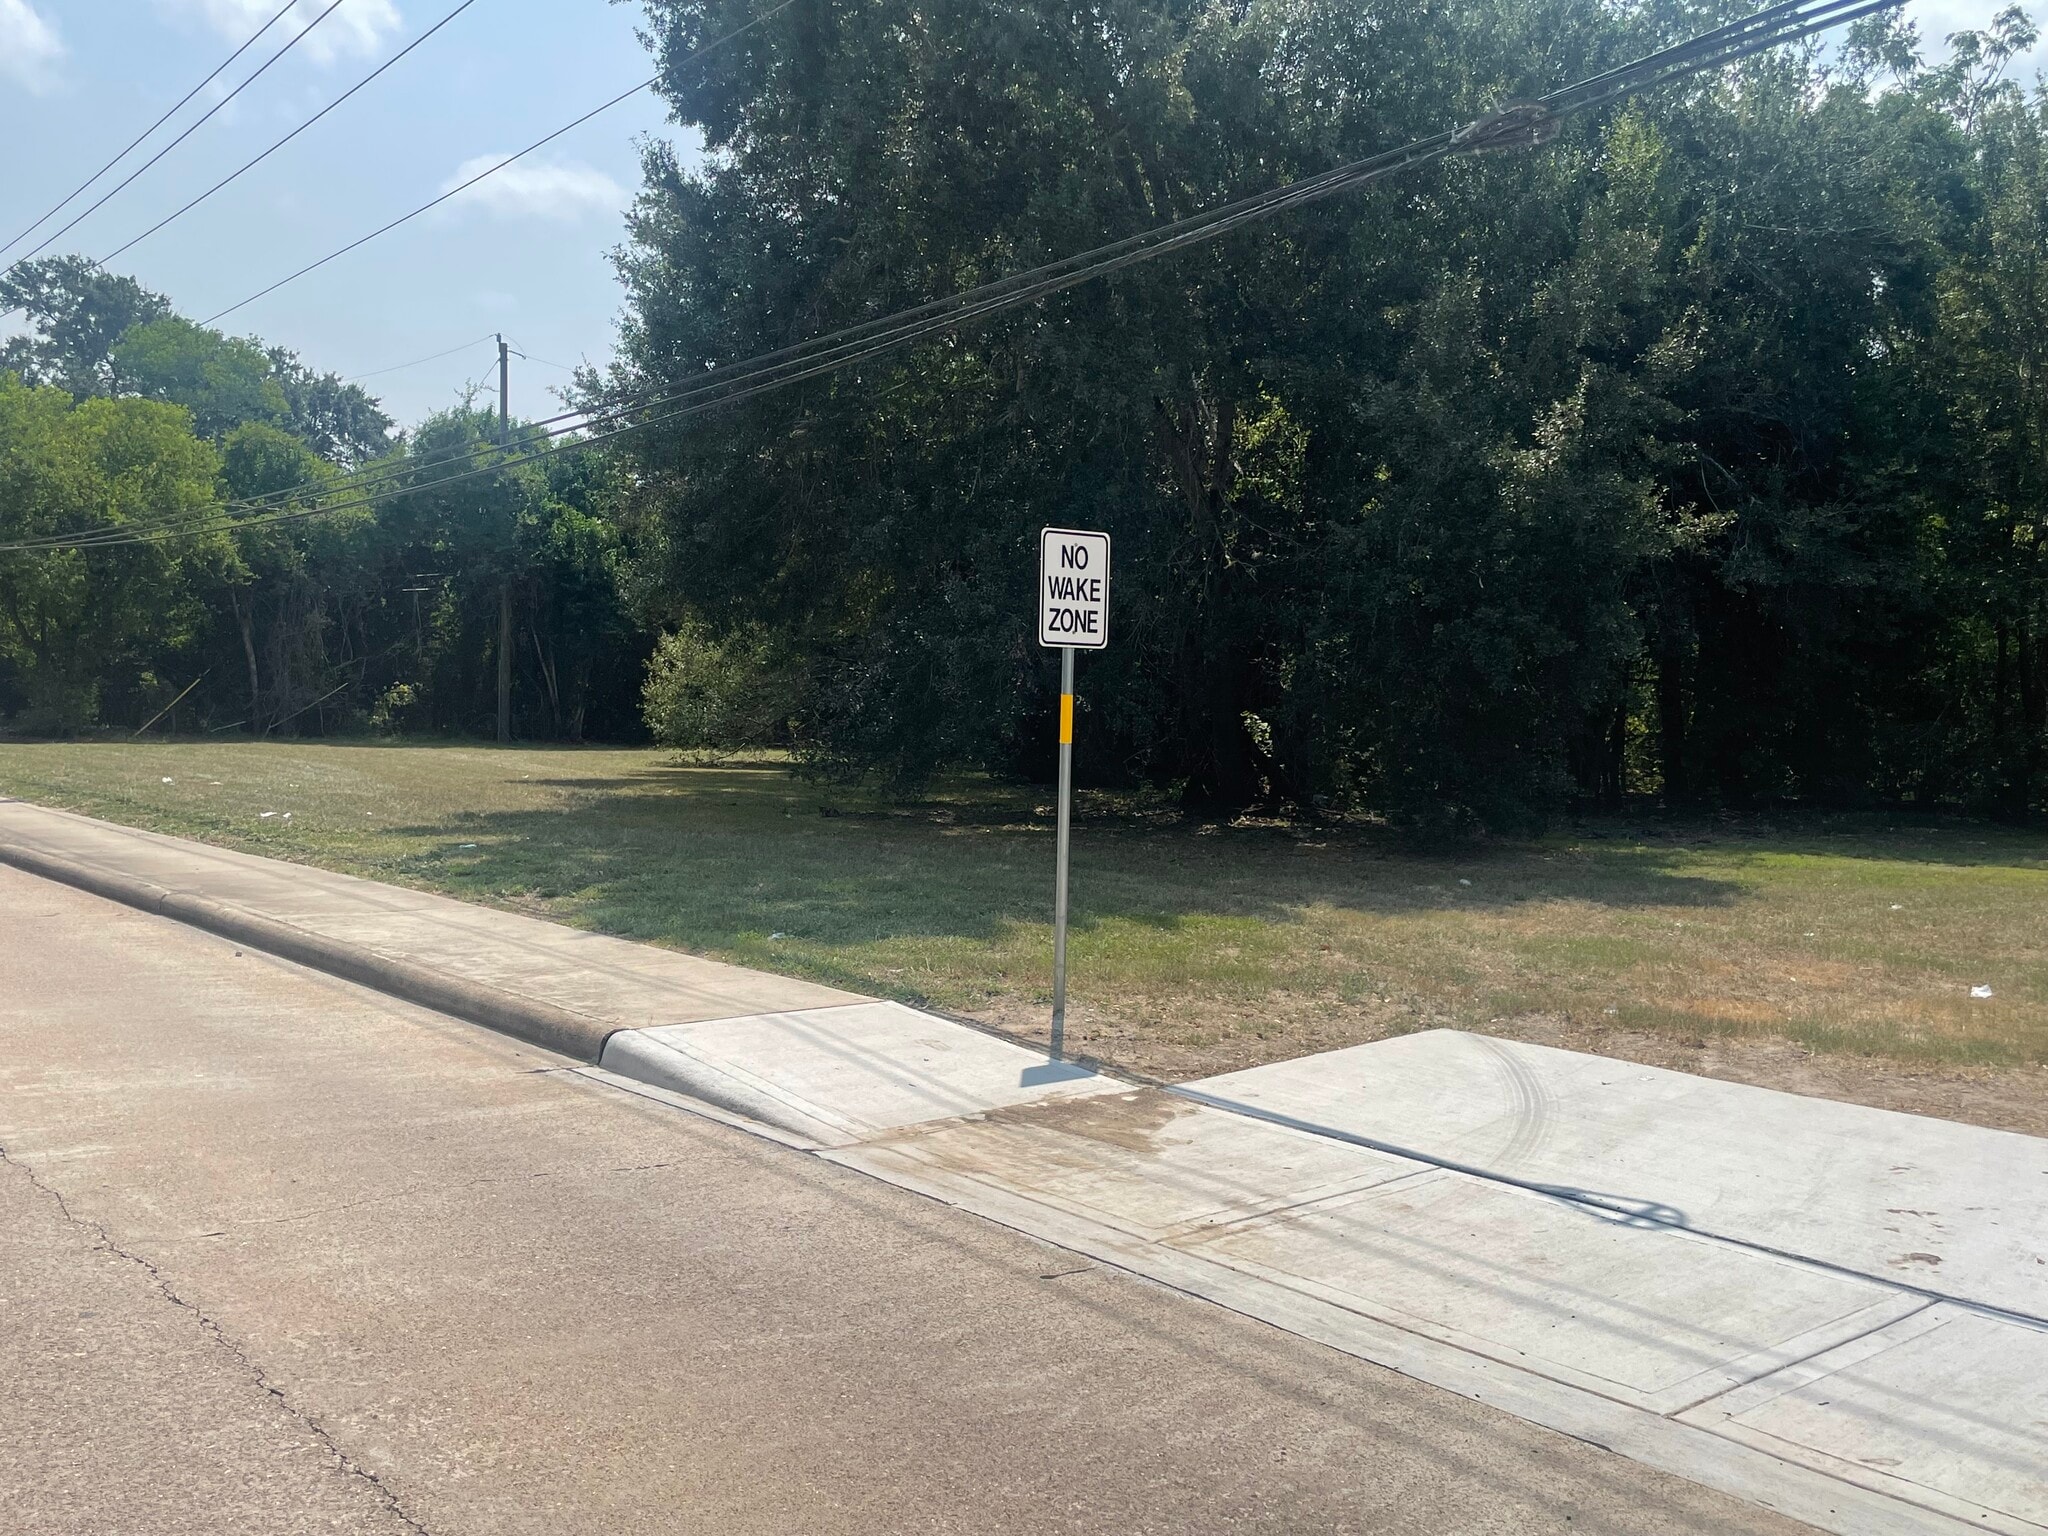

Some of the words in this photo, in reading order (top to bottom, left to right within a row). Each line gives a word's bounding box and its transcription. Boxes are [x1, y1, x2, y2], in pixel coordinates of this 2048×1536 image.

[1061, 544, 1089, 570] NO
[1048, 575, 1101, 602] WAKE
[1048, 607, 1098, 633] ZONE
